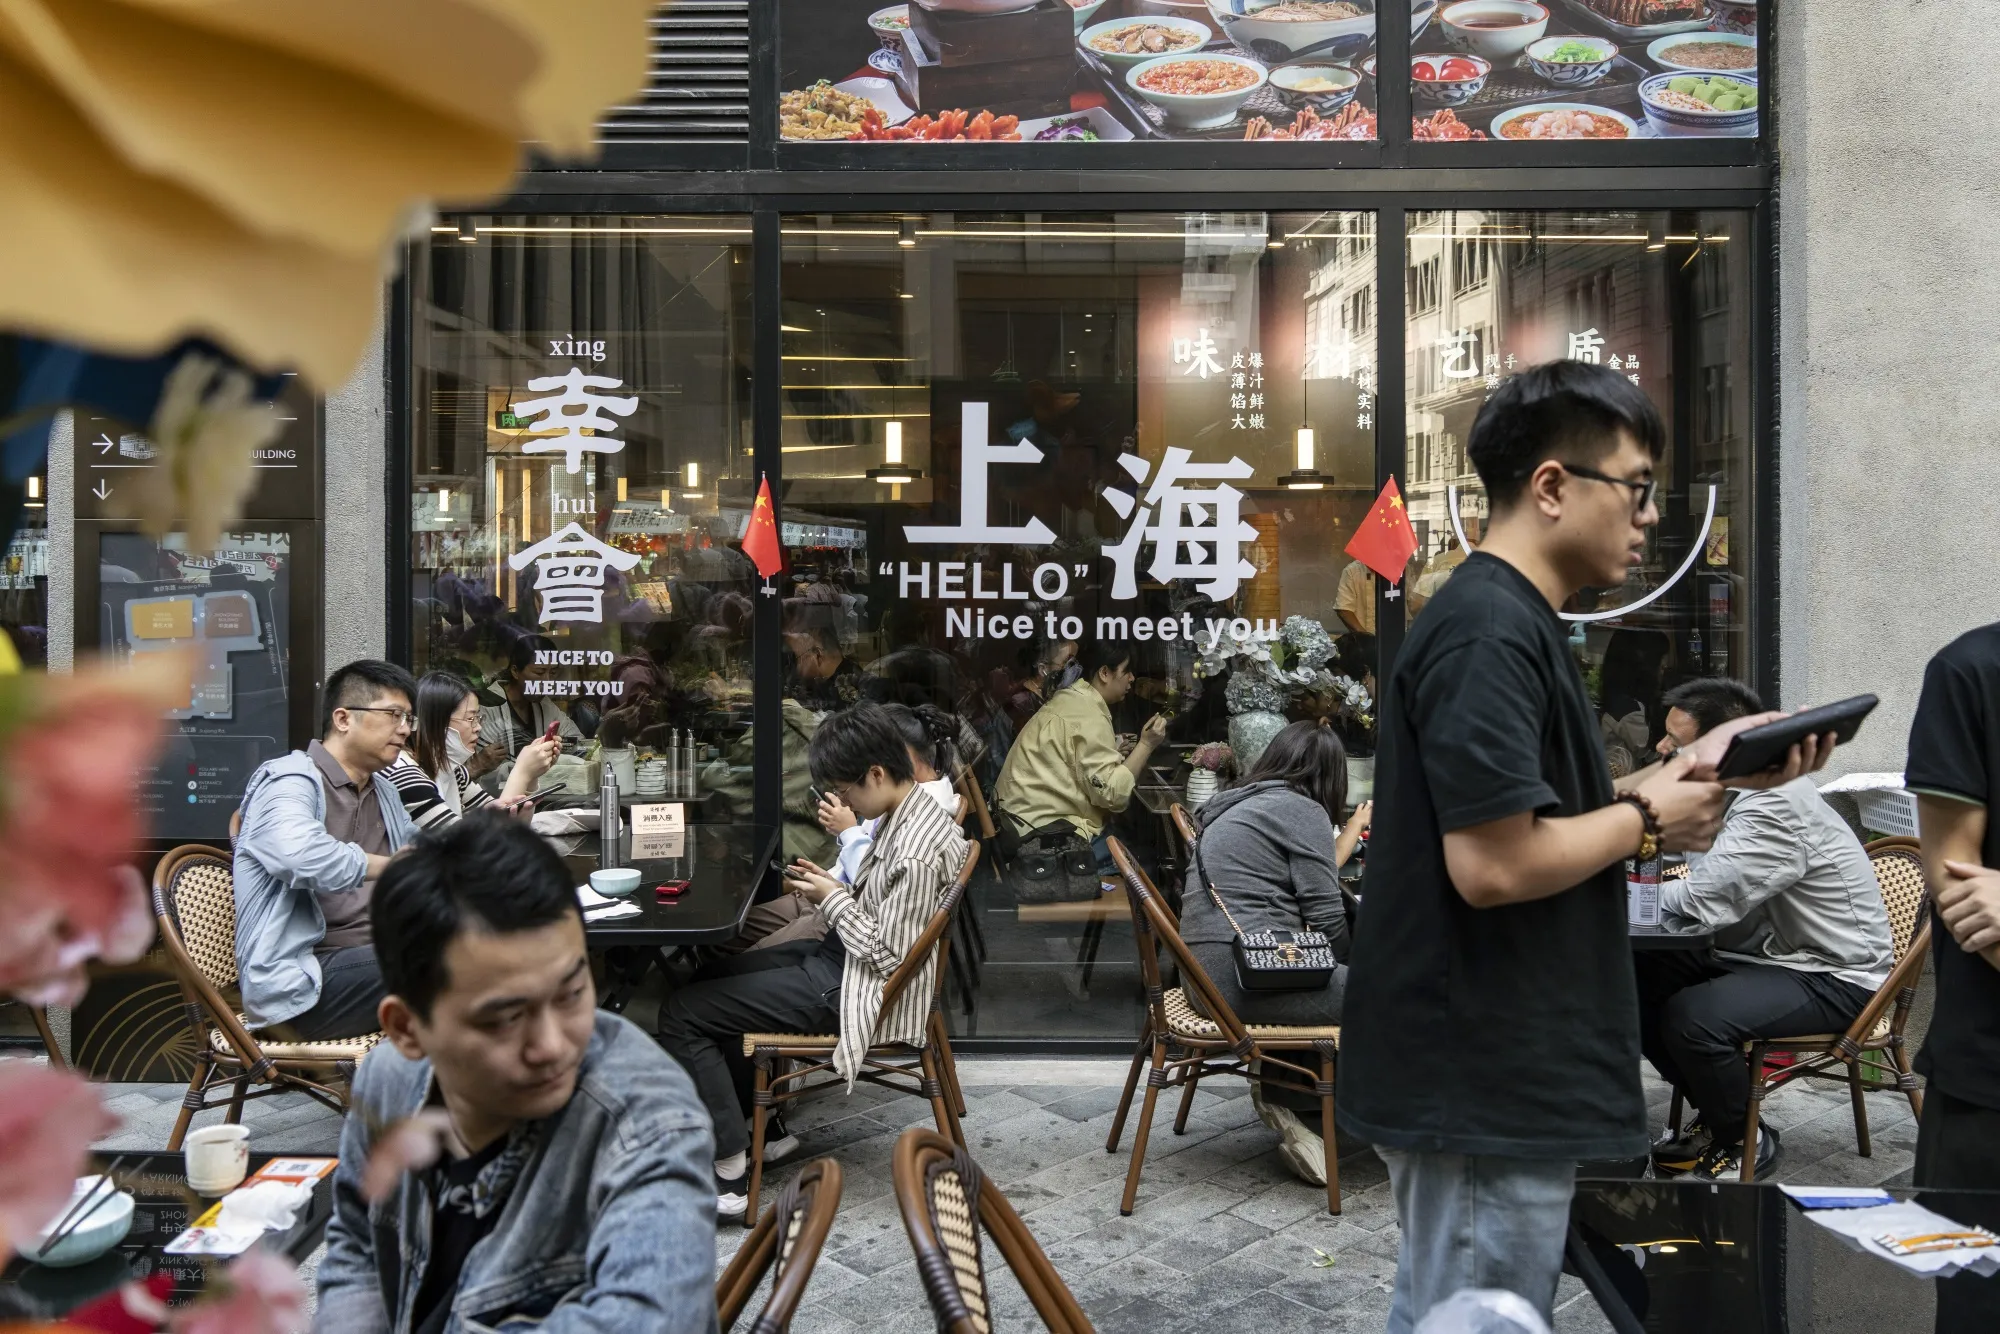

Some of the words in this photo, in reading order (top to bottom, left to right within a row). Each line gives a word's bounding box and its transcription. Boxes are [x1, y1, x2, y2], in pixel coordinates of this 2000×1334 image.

[549, 333, 606, 361] xìng
[1173, 328, 1225, 379] 味
[1434, 328, 1480, 378] 艺
[1230, 351, 1247, 430] 皮薄馅大
[1248, 351, 1265, 430] 爆汁鲜嫩
[1484, 353, 1501, 402] 现蒸
[513, 366, 639, 475] 幸
[553, 491, 597, 514] huì
[902, 401, 1260, 603] 上海
[508, 521, 642, 625] 會
[878, 562, 1089, 600] “HELLO”
[946, 607, 1034, 639] Nice
[1045, 611, 1084, 640] to
[1096, 611, 1196, 641] meet
[1205, 615, 1279, 650] you
[534, 650, 585, 665] NICE
[587, 650, 614, 665] TO
[523, 680, 582, 696] MEET
[583, 681, 624, 696] YOU
